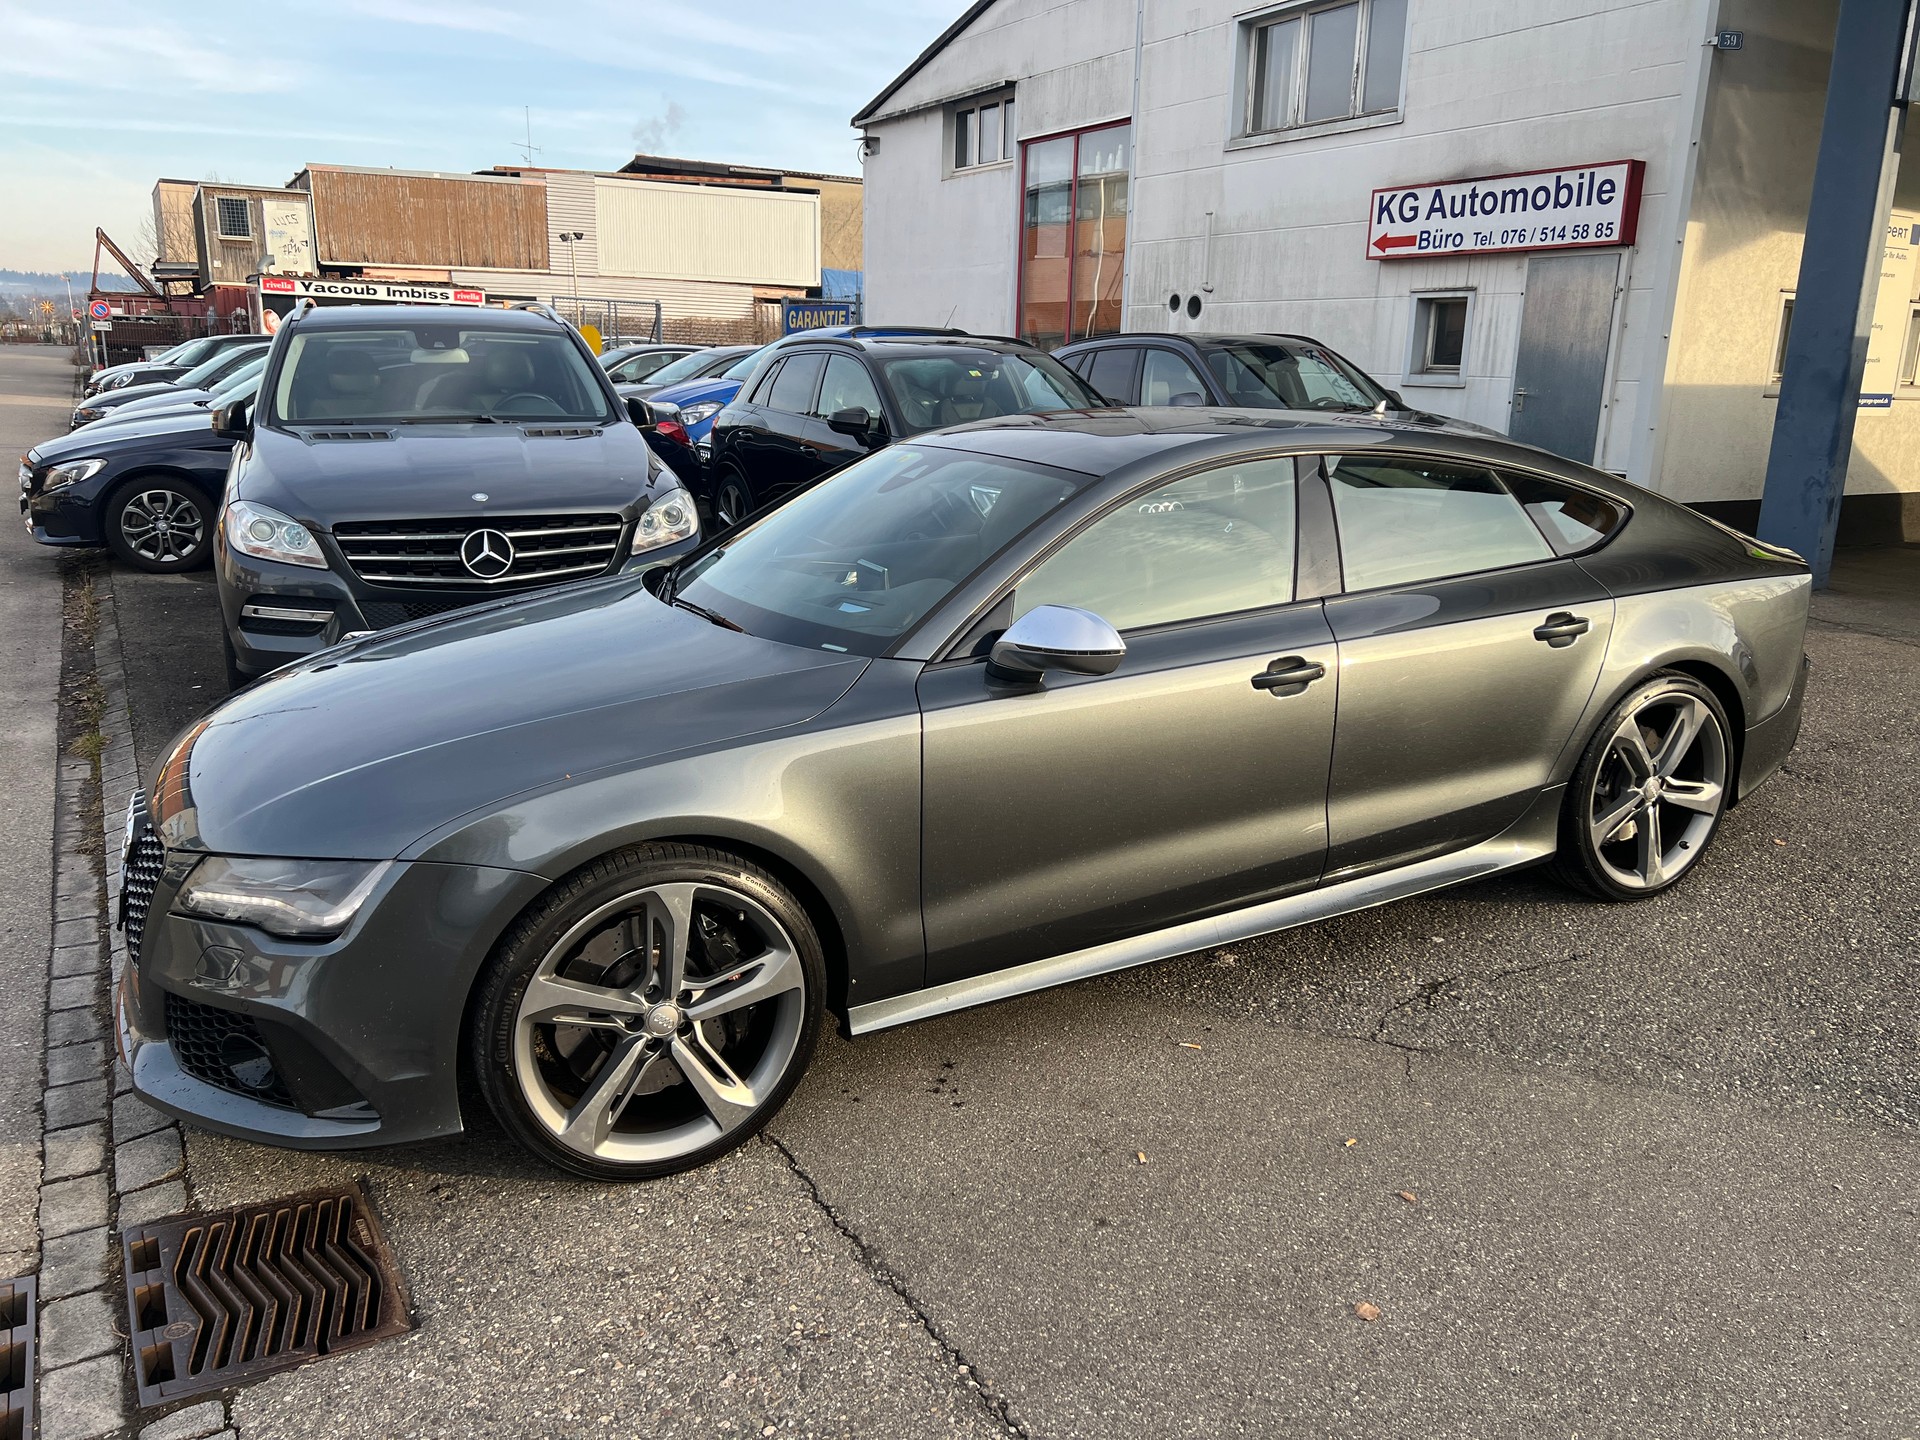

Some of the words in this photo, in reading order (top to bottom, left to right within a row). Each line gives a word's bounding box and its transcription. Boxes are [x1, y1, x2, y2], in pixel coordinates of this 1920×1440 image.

[1377, 191, 1420, 225] KG
[1425, 171, 1616, 220] Automobile
[1418, 229, 1463, 250] Büro
[1473, 231, 1496, 246] Tel.
[1501, 229, 1527, 245] 076
[1530, 227, 1537, 243] /
[1540, 225, 1566, 242] 514
[1571, 223, 1590, 240] 58
[1594, 221, 1615, 238] 85
[266, 281, 292, 289] rivella
[300, 281, 378, 296] Yacoub
[386, 287, 450, 300] Imbiss
[457, 292, 481, 301] rivella
[788, 310, 847, 329] GARANTIE
